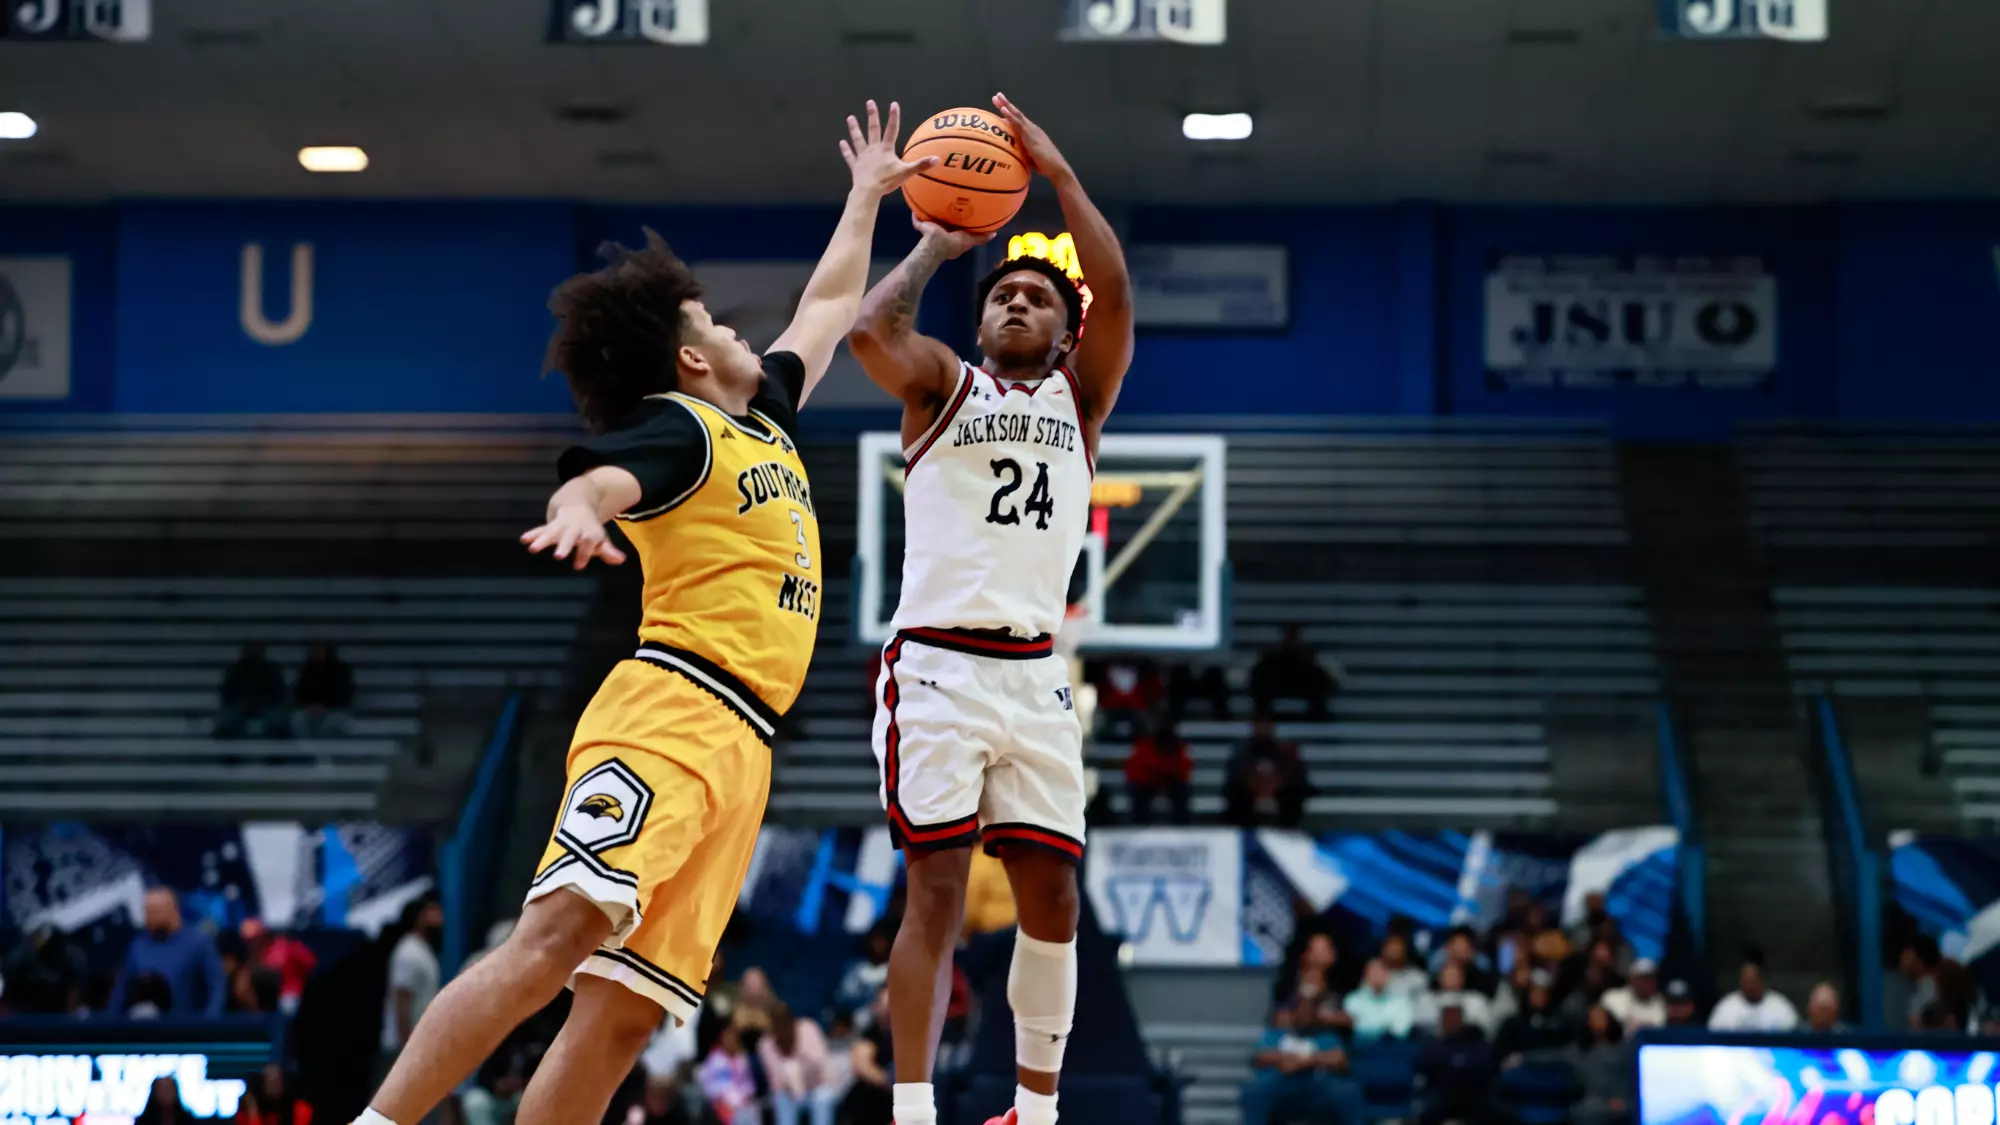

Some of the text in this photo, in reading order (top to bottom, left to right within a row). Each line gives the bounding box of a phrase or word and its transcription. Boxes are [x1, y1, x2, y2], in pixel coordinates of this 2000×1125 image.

[933, 113, 1016, 148] Wilson
[944, 152, 997, 175] EVO
[241, 243, 313, 344] U
[1508, 299, 1677, 347] JSU
[953, 413, 1076, 452] JACKSON STATE
[985, 457, 1054, 530] 24
[789, 508, 811, 569] 3
